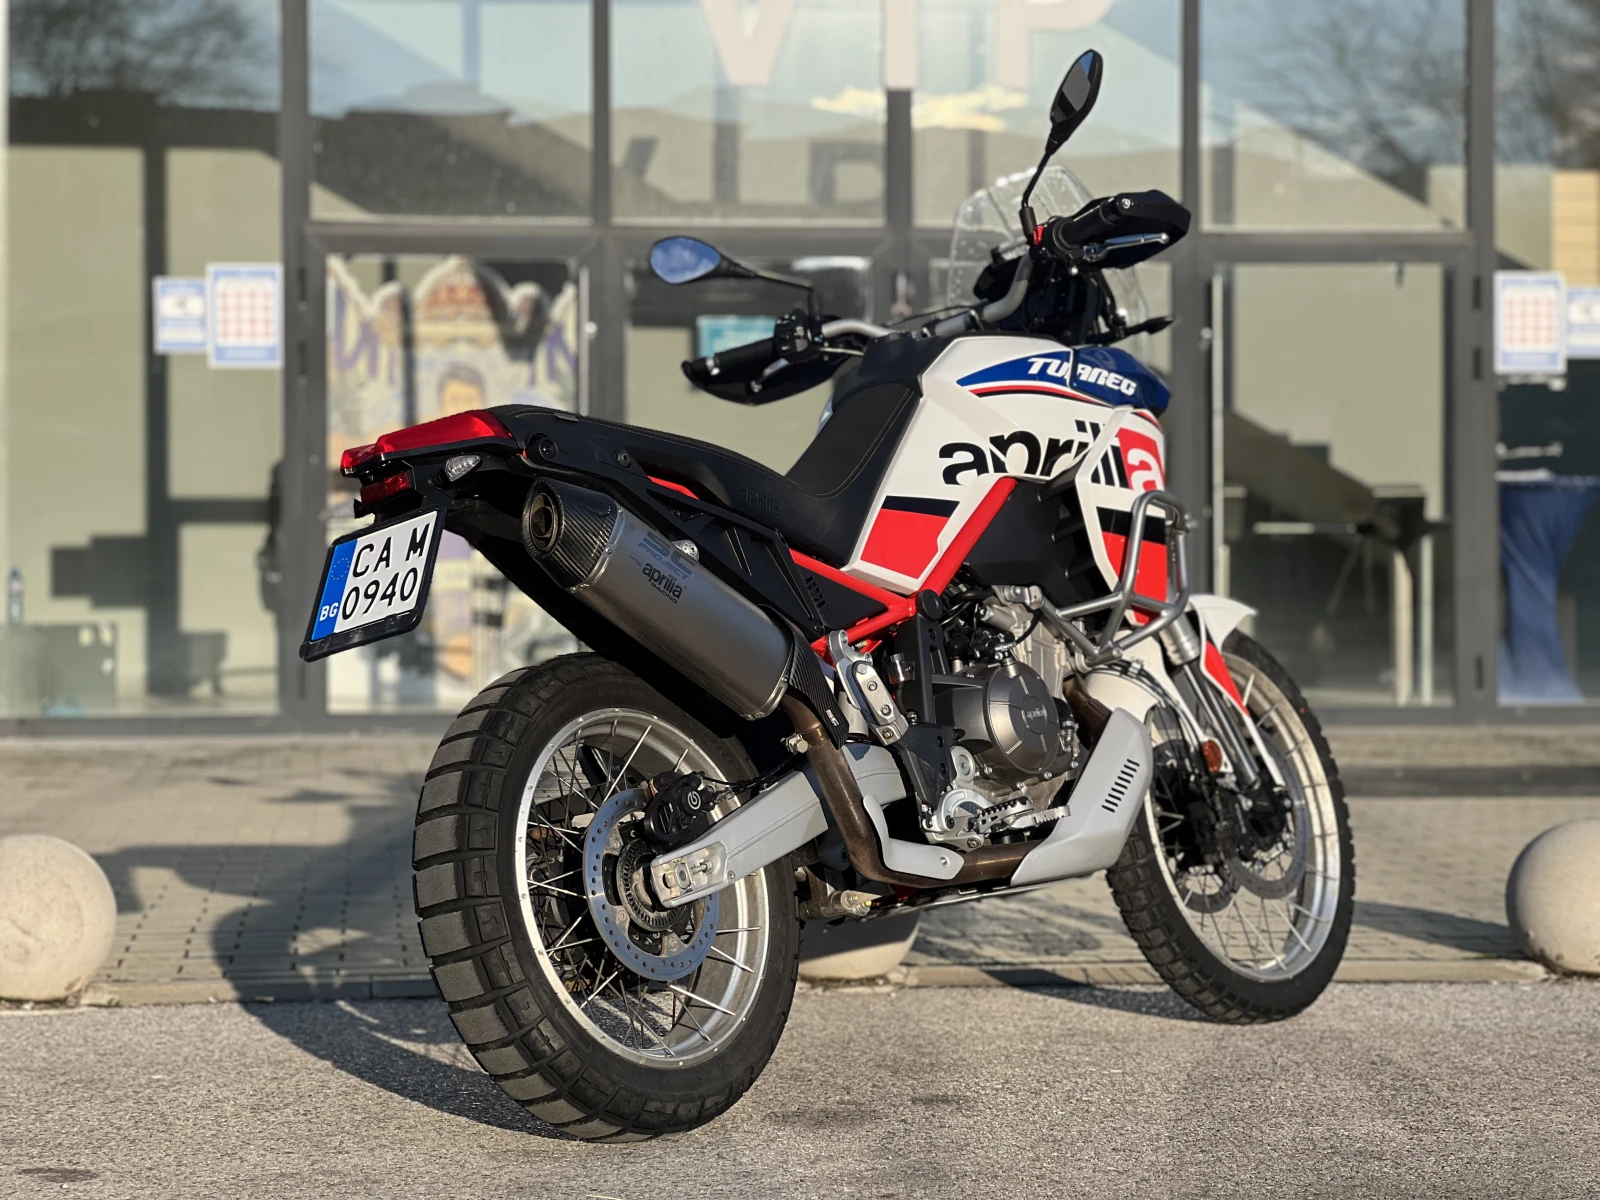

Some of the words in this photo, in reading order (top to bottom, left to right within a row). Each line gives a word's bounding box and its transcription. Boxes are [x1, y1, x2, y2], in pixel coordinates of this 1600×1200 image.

[1027, 357, 1138, 396] TUAREG
[938, 419, 1165, 492] aprilia
[352, 536, 392, 578] CA
[405, 523, 431, 562] M
[341, 567, 418, 620] 0940
[642, 562, 683, 600] aprilia
[650, 582, 678, 605] RACING
[319, 602, 339, 621] BG
